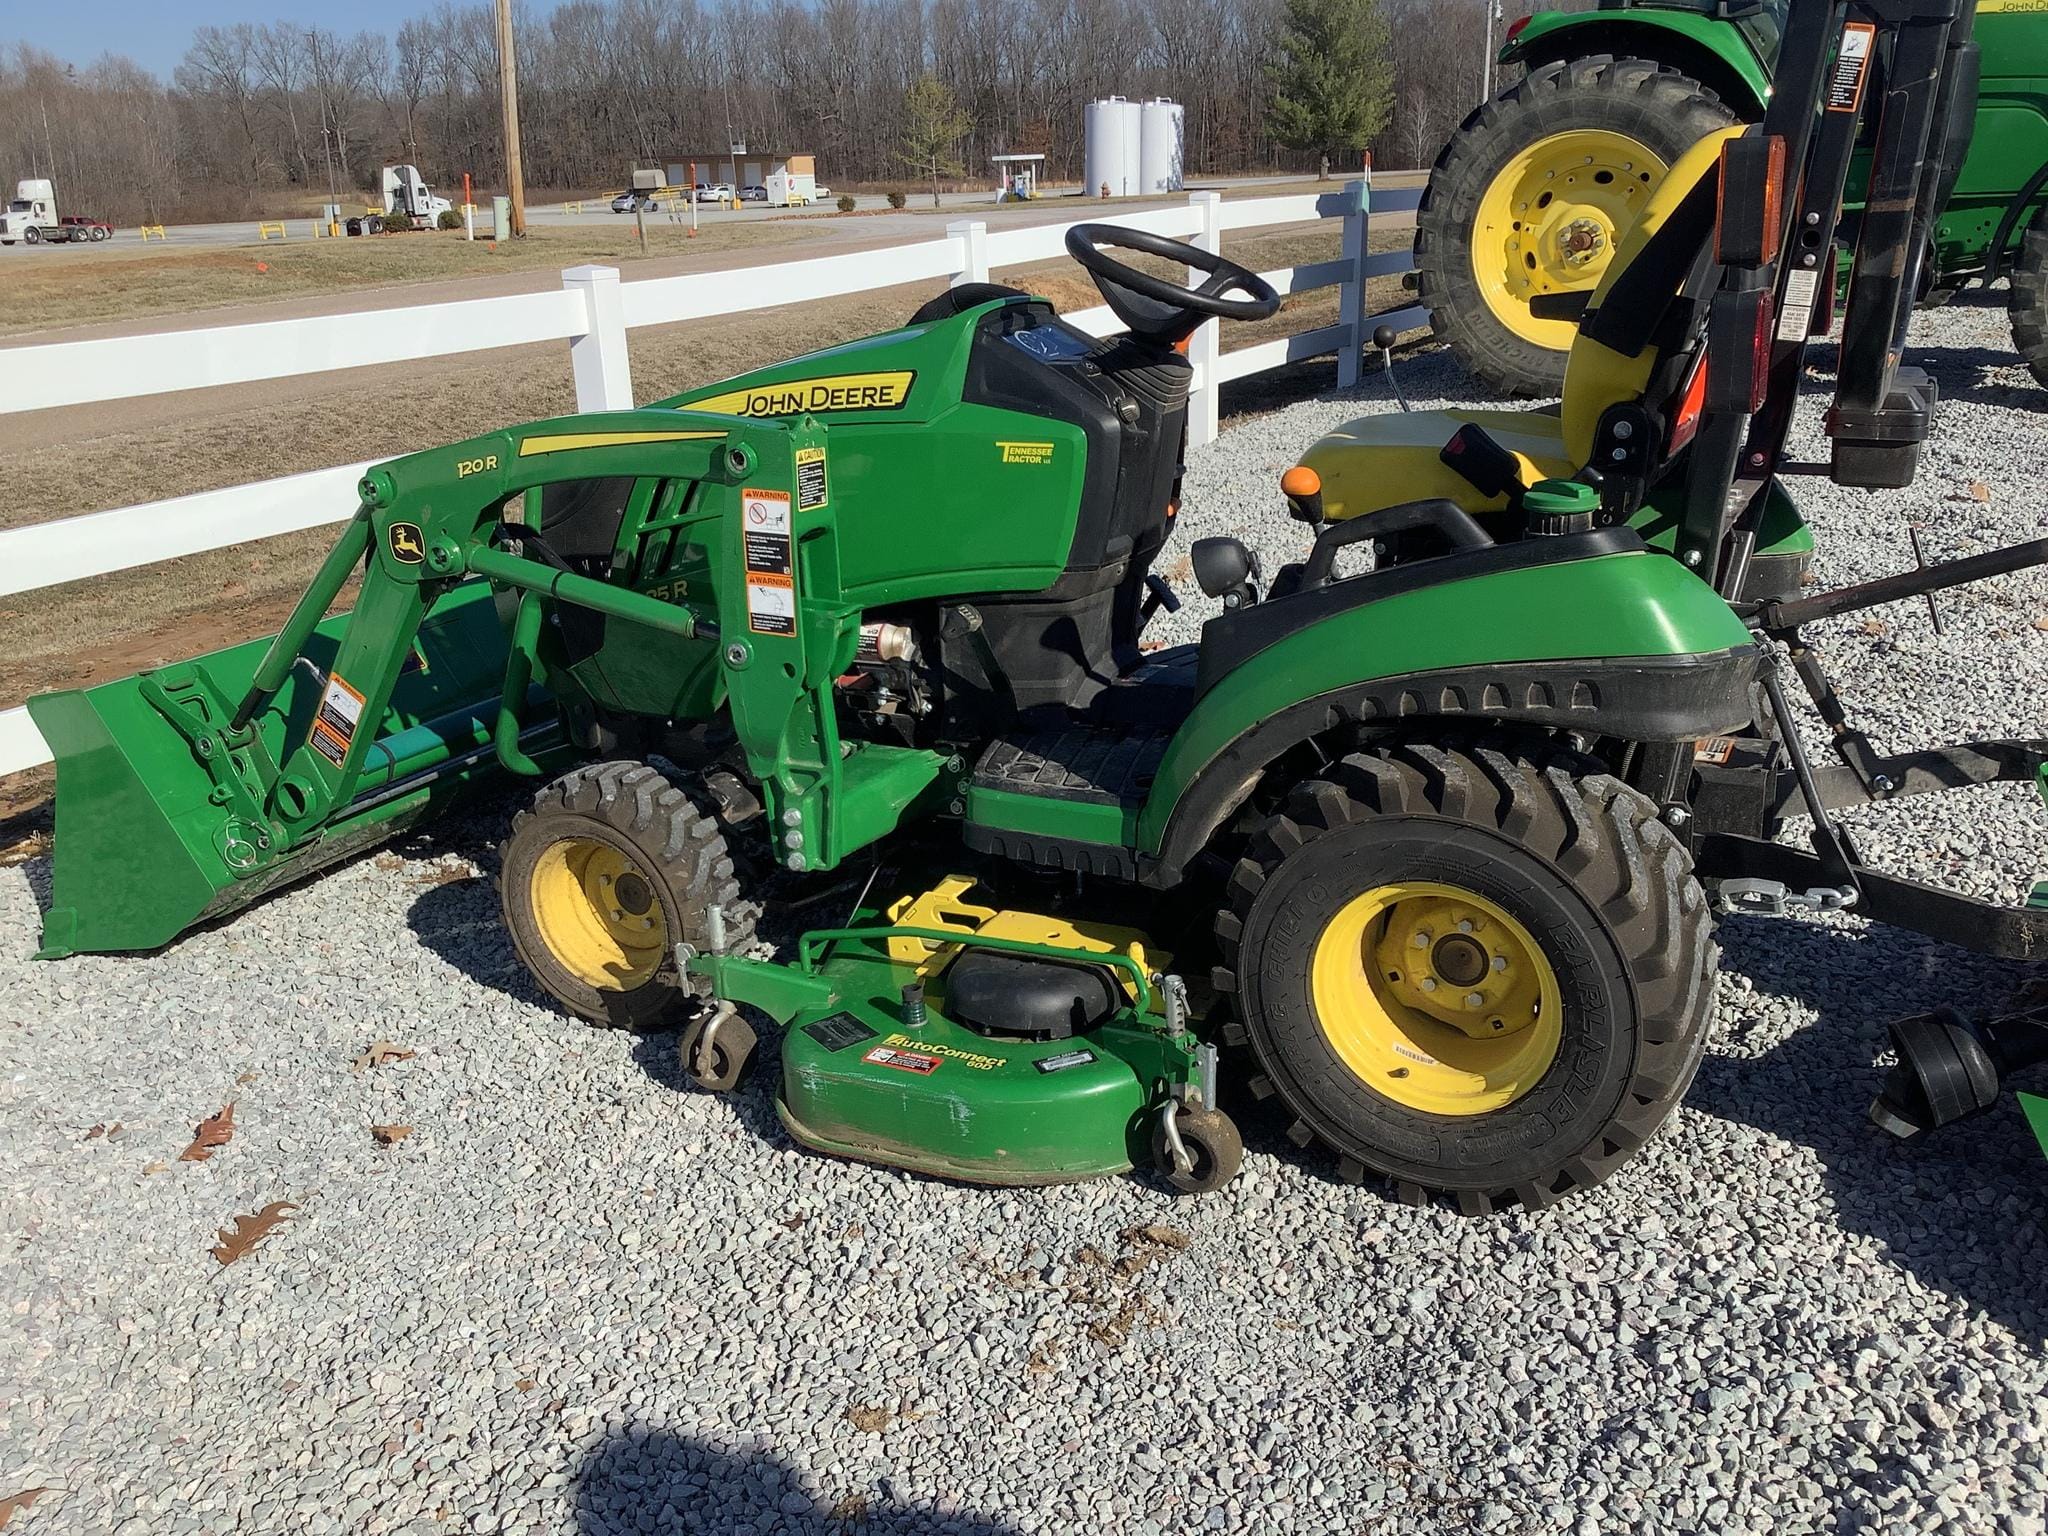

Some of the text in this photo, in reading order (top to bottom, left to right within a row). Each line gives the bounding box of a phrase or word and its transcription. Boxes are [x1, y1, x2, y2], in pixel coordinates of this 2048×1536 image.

[1998, 1, 2034, 11] JOHN
[737, 385, 895, 416] JOHN DEERE
[995, 441, 1055, 458] TENNESSEE
[752, 490, 789, 501] WARNING
[755, 576, 791, 587] WARNING
[1549, 921, 1608, 1127] CARLISLE
[883, 1033, 1008, 1067] AutoConnect
